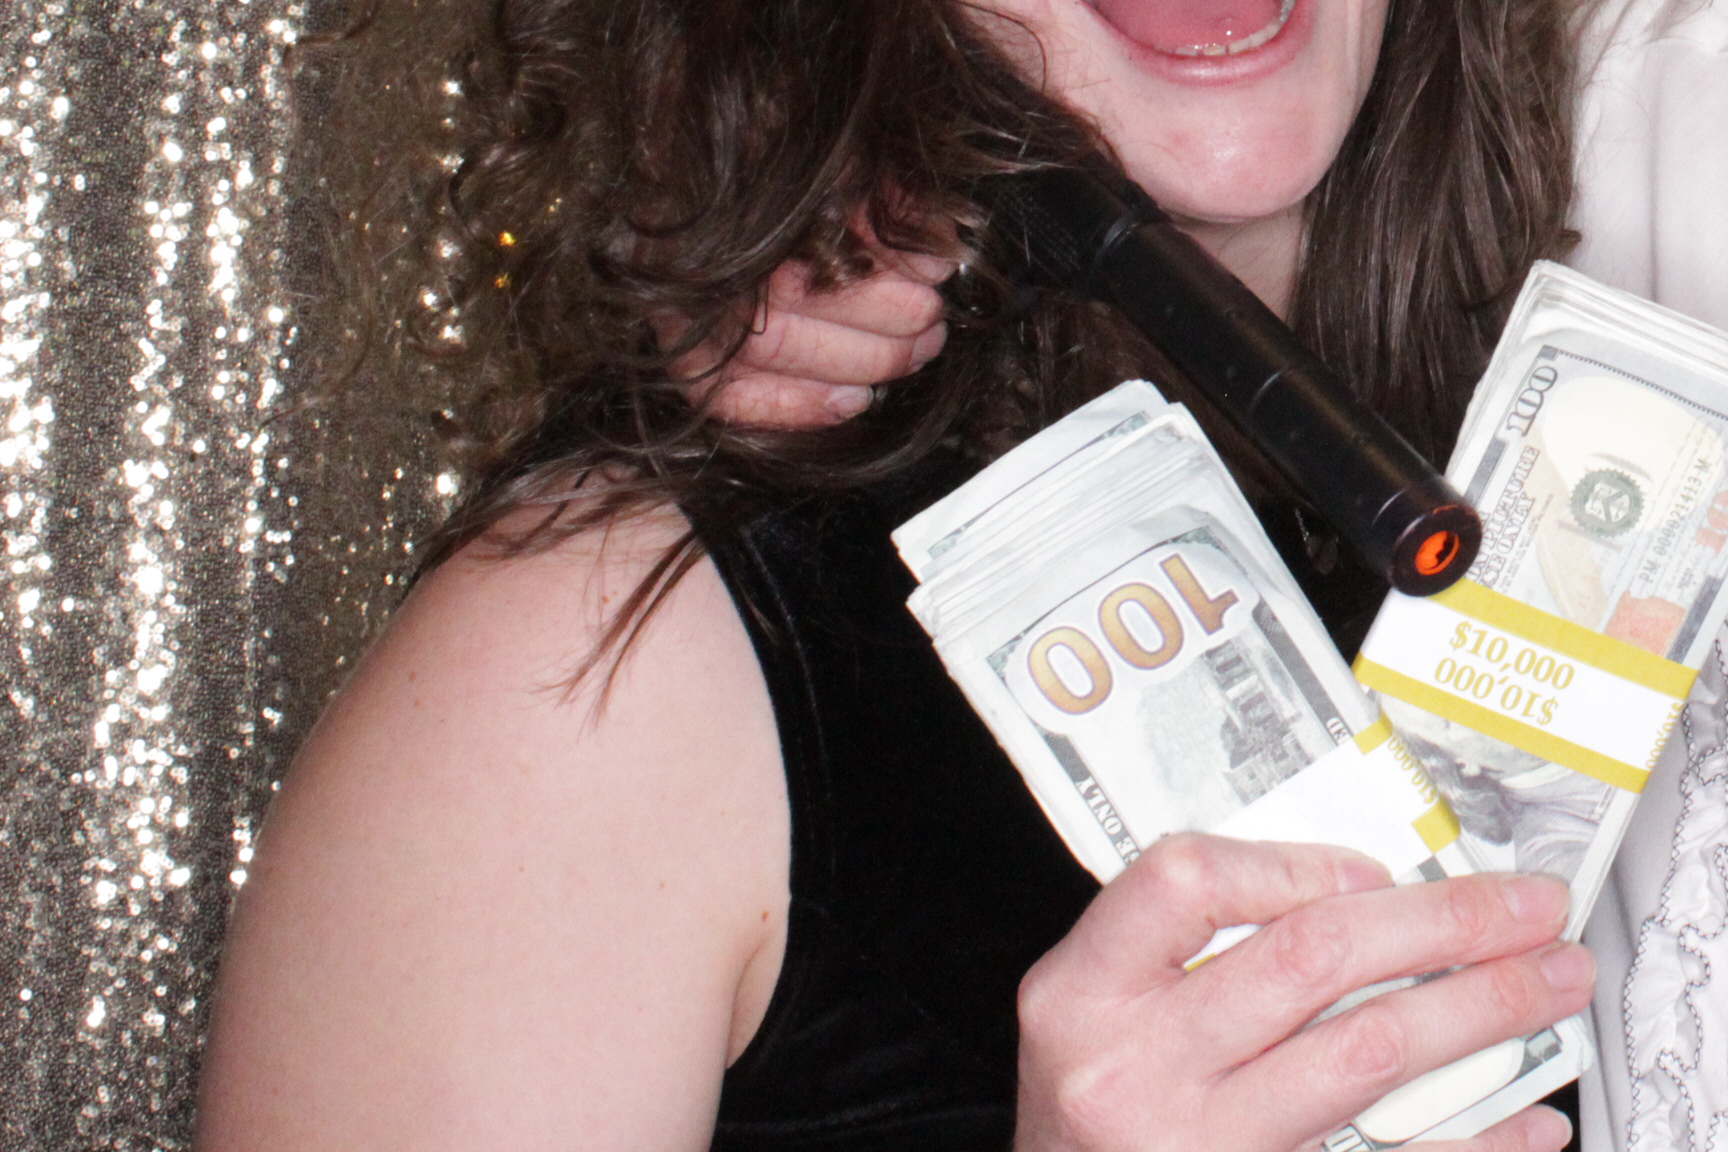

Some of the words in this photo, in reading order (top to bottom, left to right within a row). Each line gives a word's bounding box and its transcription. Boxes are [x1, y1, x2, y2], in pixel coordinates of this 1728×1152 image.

[1507, 366, 1558, 437] 100
[1484, 445, 1541, 549] PICTURE
[1497, 491, 1536, 555] ONLY
[1027, 553, 1239, 715] 100
[1449, 620, 1575, 690] $10,000
[1434, 657, 1559, 726] $10,000
[1077, 776, 1123, 836] ONLY
